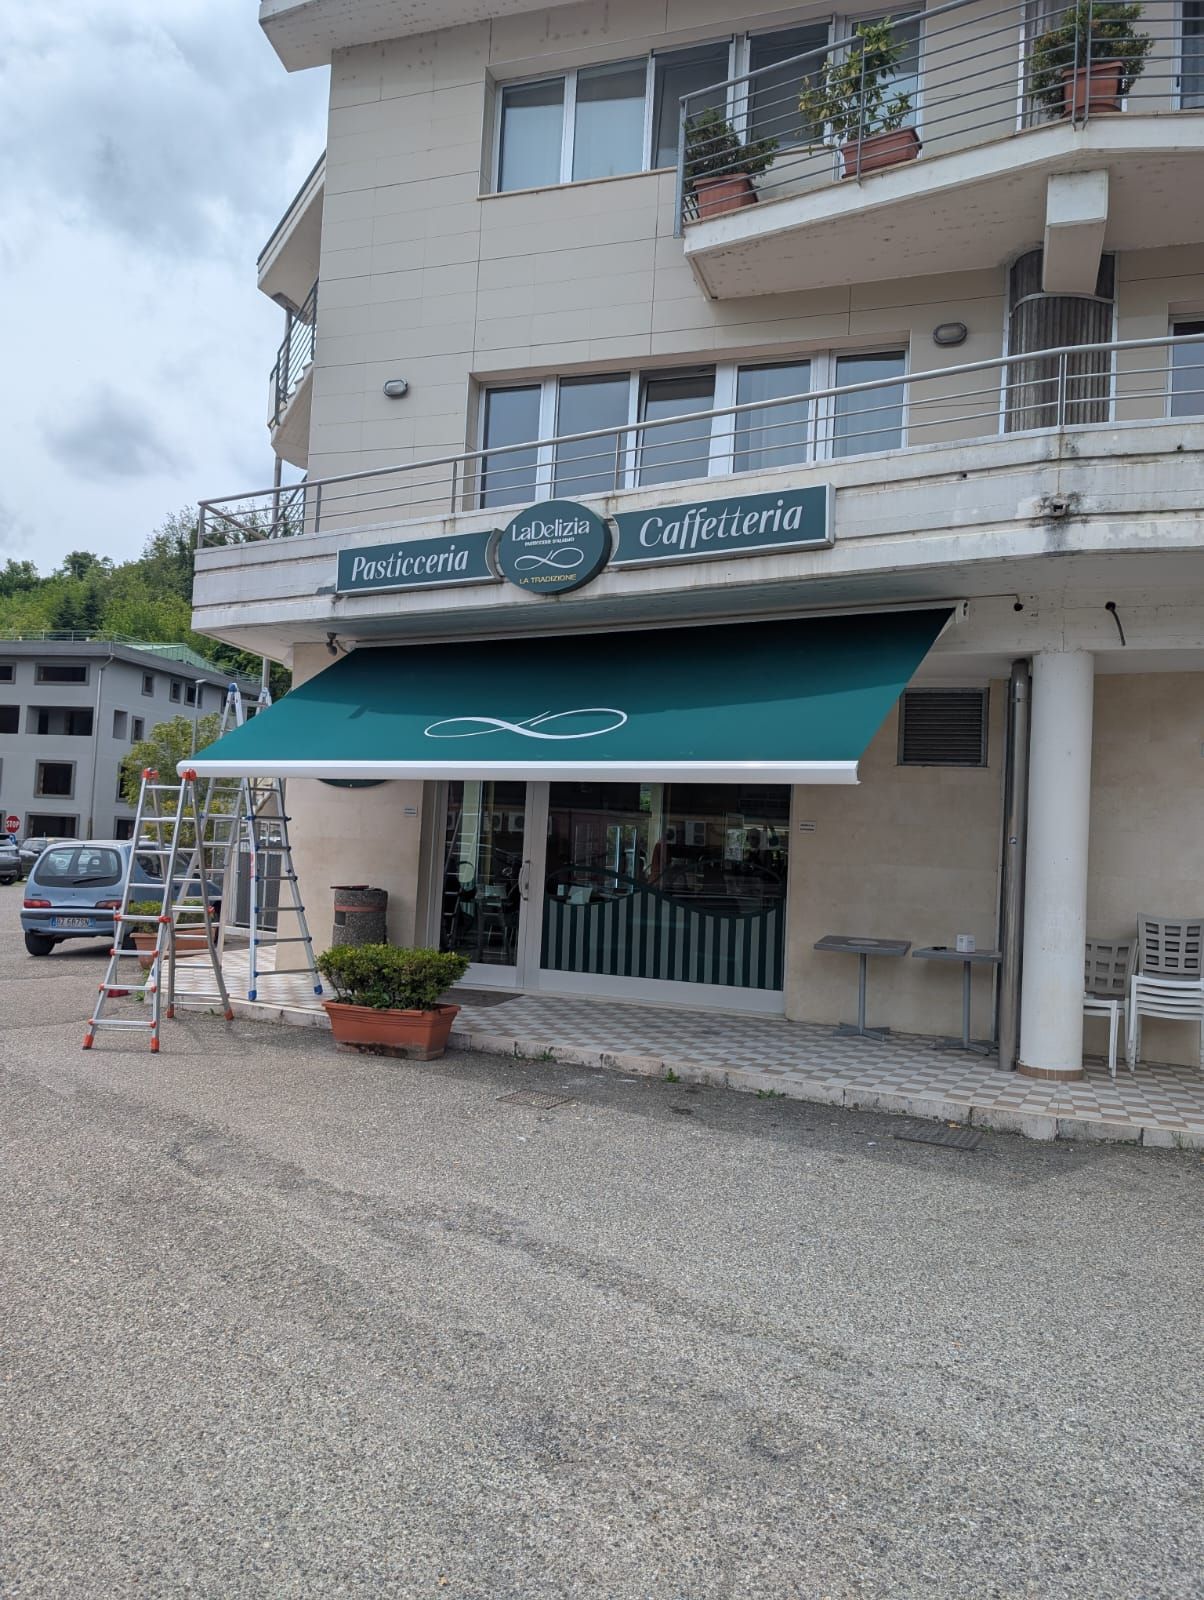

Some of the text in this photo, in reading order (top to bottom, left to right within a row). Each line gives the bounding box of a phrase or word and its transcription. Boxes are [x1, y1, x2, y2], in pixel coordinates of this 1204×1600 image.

[511, 517, 590, 542] LaDelizia
[639, 499, 803, 550] Caffetteria
[351, 544, 469, 582] Pasticceria
[519, 573, 577, 585] LA TRADIZIONE
[6, 820, 19, 828] STOP
